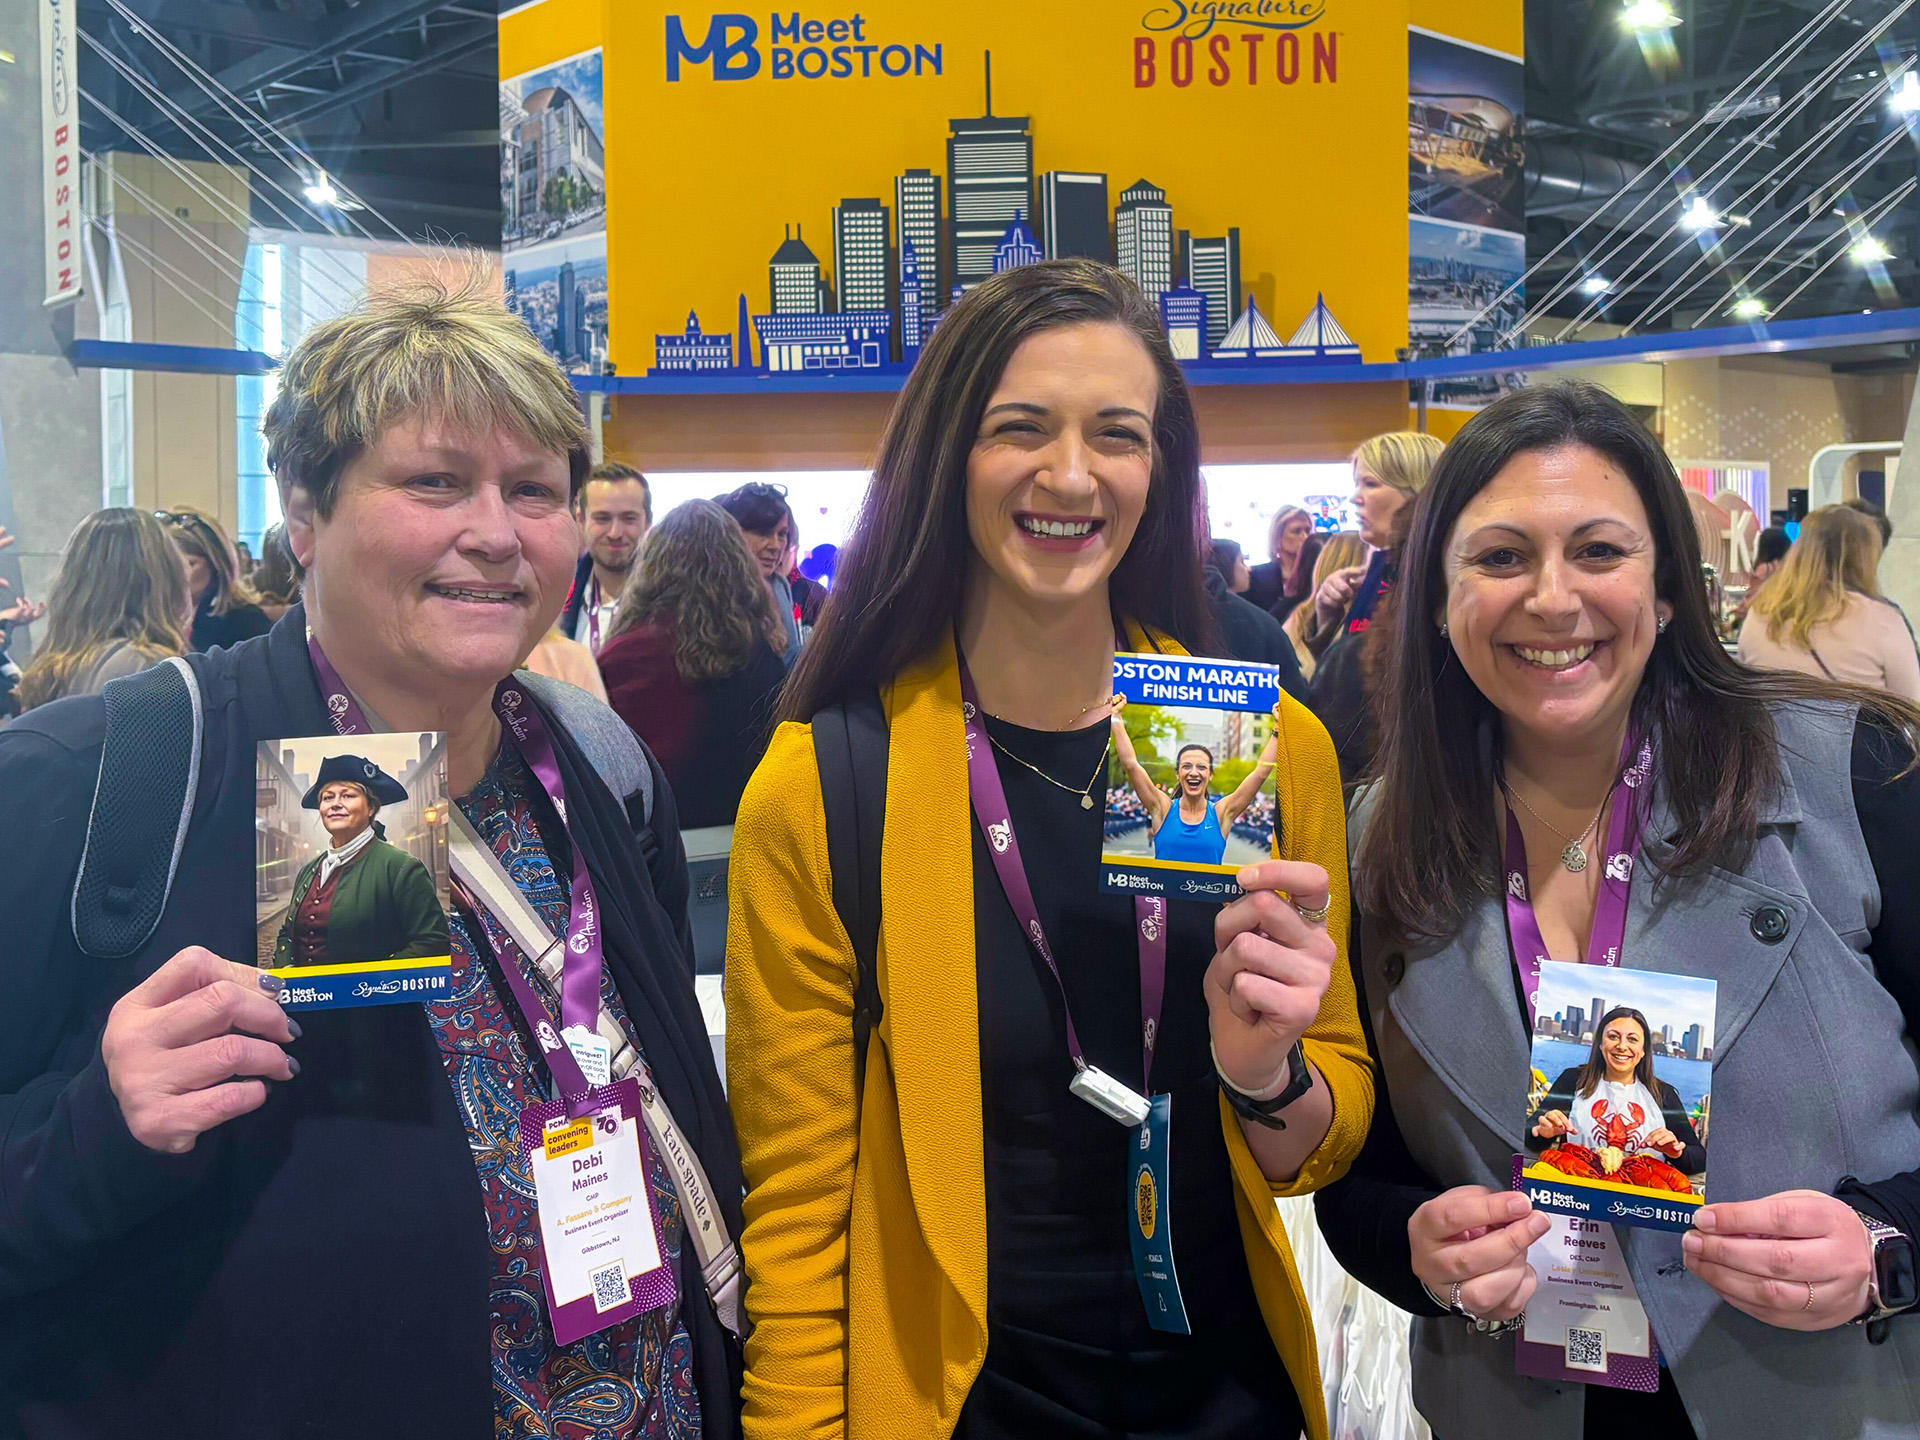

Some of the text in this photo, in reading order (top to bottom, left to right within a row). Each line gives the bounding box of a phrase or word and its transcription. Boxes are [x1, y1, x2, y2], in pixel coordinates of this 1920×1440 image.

[771, 12, 866, 44] Meet
[665, 14, 761, 82] MB
[771, 43, 943, 79] BOSTON
[1134, 32, 1337, 88] BOSTON
[55, 124, 72, 291] BOSTON
[1143, 683, 1248, 704] FINISH LINE
[499, 706, 527, 742] Anaheim
[1108, 872, 1128, 887] MB
[1129, 881, 1164, 890] BOSTON
[1180, 879, 1224, 894] Signature
[579, 889, 596, 936] Anaheim
[352, 976, 446, 998] Signature BOSTON
[292, 992, 333, 1003] BOSTON
[548, 1119, 569, 1131] PCMA
[548, 1126, 589, 1144] convening
[548, 1139, 578, 1155] leaders
[572, 1151, 603, 1174] Debi
[572, 1171, 609, 1191] Maines
[663, 1125, 707, 1219] kate spade
[586, 1192, 599, 1201] CMP
[600, 1195, 633, 1211] Company
[1530, 1188, 1551, 1204] MB
[1552, 1198, 1590, 1211] BOSTON
[1607, 1200, 1655, 1219] Signature
[564, 1208, 629, 1236] Business Event Organizer
[1569, 1218, 1599, 1233] Erin
[581, 1235, 621, 1254] Gibbstown, NJ
[1564, 1236, 1606, 1250] Reeves
[1547, 1276, 1624, 1290] Business Event Organizer
[1559, 1299, 1599, 1310] Framingham,
